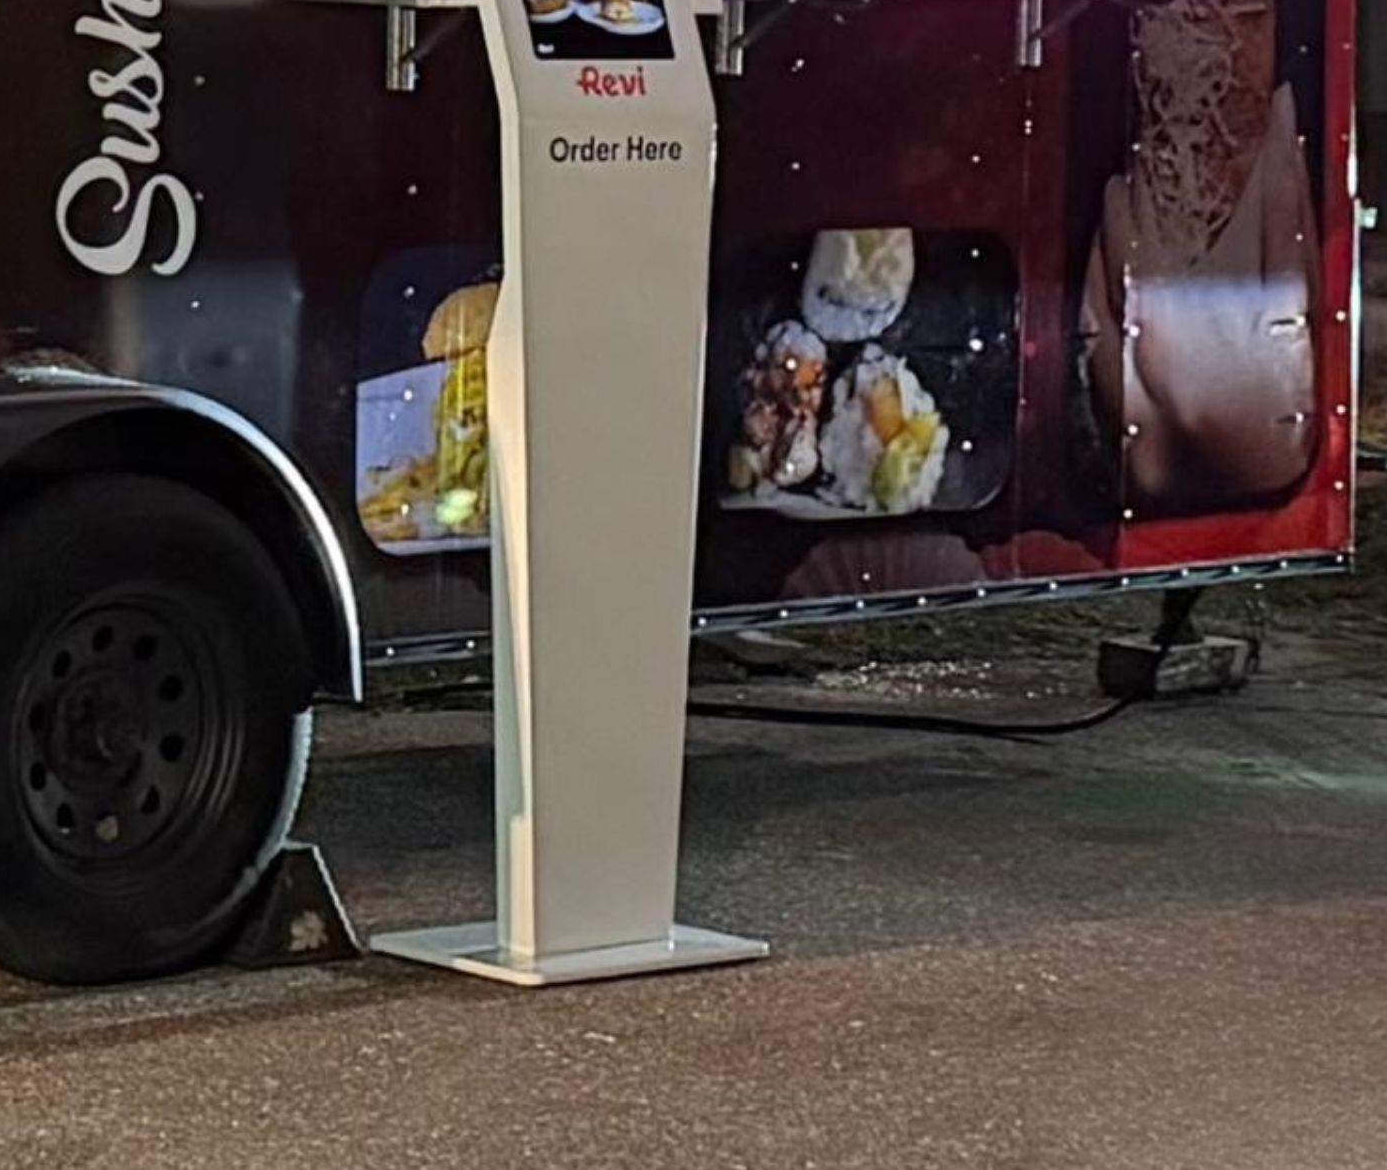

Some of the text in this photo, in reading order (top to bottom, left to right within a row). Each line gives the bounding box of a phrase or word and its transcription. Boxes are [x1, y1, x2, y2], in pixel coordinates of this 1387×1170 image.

[576, 66, 646, 96] Revi
[549, 136, 683, 163] Order Here
